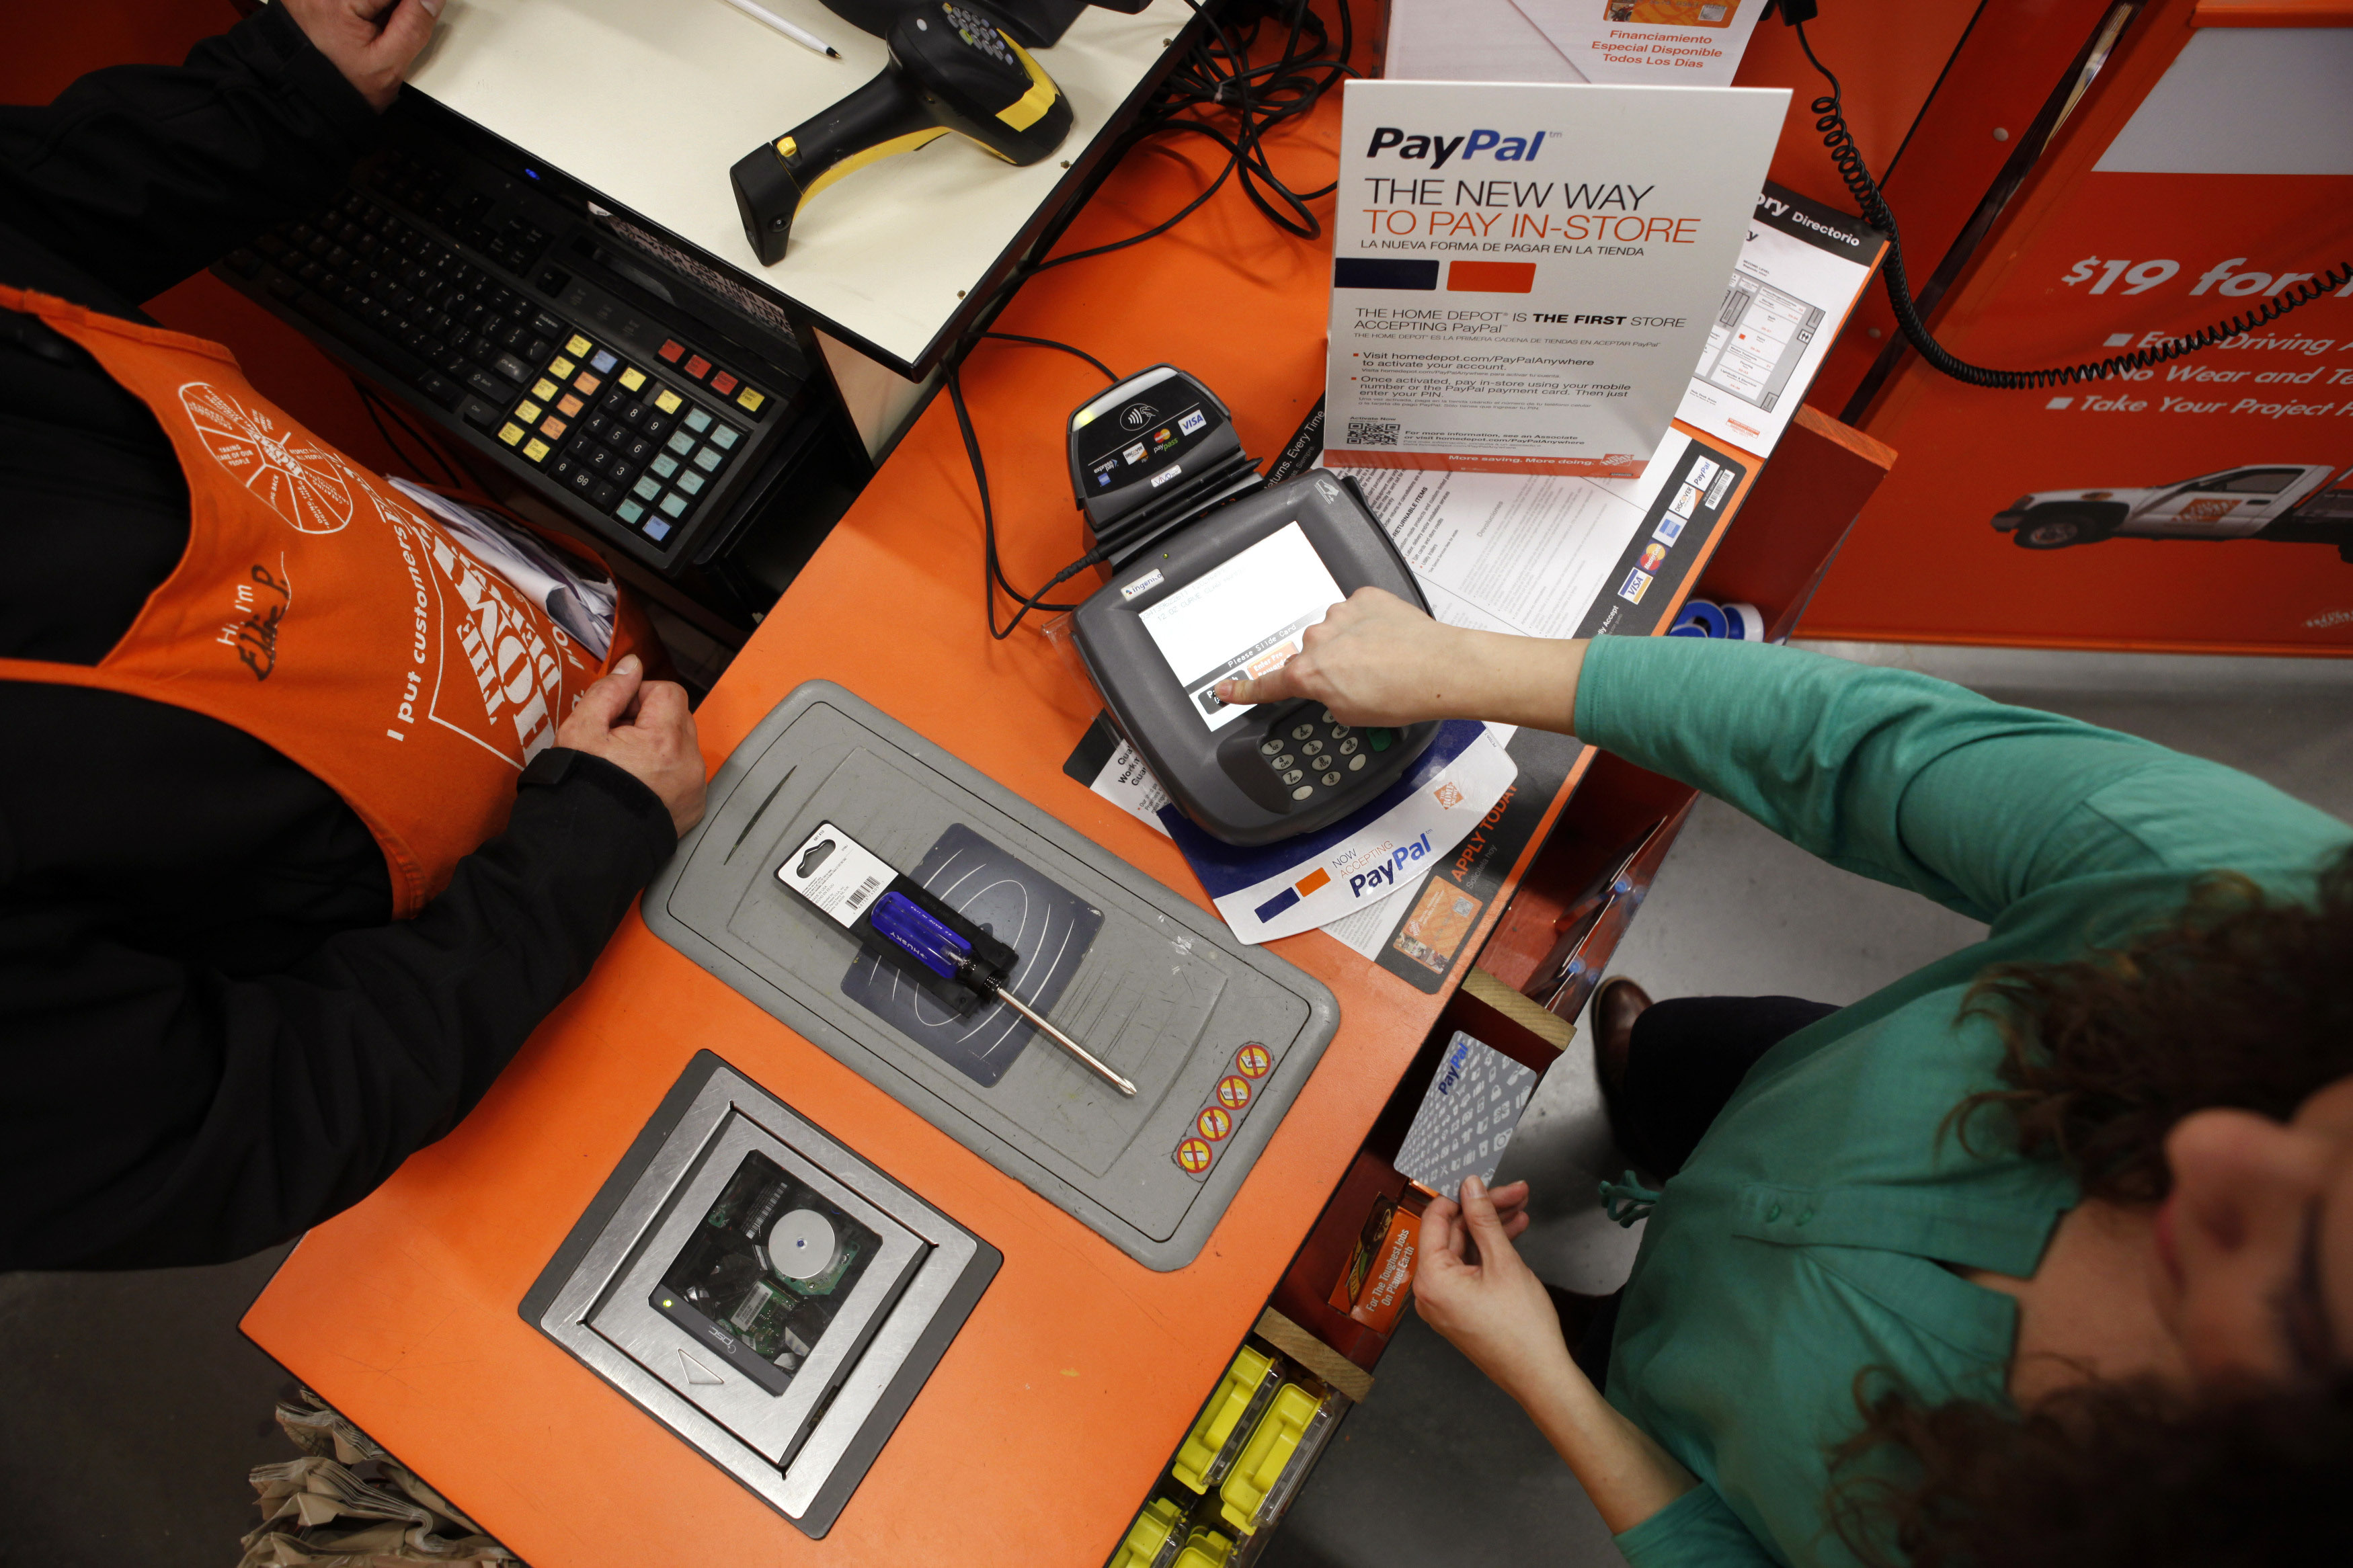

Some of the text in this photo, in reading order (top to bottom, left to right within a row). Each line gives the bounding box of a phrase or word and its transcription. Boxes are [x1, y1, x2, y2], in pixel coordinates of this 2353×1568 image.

[1609, 30, 1712, 44] Financiamiento
[1591, 40, 1722, 58] Especial Disponible
[1603, 53, 1704, 68] Todos Los Días
[1366, 127, 1546, 169] PayPal
[1364, 177, 1655, 211] THE NEW WAY
[1363, 209, 1702, 243] TO PAY IN-STORE
[1791, 210, 1860, 247] Directorio
[1361, 239, 1644, 256] LA NUEVA FORMA DE PAGAR EN LA TIENDA
[2061, 255, 2180, 295] $19
[2189, 257, 2315, 296] for
[1354, 320, 1447, 332] ACCEPTING
[1355, 308, 1388, 319] THE
[1392, 309, 1443, 320] HOME
[1513, 313, 1527, 323] IS
[1533, 313, 1569, 324] THE
[1574, 315, 1627, 325] FIRST
[1630, 317, 1687, 328] STORE
[1363, 352, 1595, 366] Visit homedepot.com/PayPalAnywhere
[1378, 360, 1423, 368] activate
[1456, 362, 1507, 370] account.
[1396, 376, 1451, 385] activated,
[1455, 379, 1476, 387] pay
[1480, 378, 1524, 387] in-store
[1528, 380, 1559, 390] using
[2166, 365, 2251, 382] Wear
[2254, 366, 2326, 384] and
[609, 395, 619, 403] 7
[1445, 385, 1484, 393] PayPal
[1488, 387, 1538, 395] payment
[1606, 390, 1628, 398] just
[630, 409, 639, 418] 8
[2080, 394, 2148, 412] Take
[2159, 397, 2228, 413] Your
[2229, 398, 2335, 419] Project
[592, 419, 600, 427] 4
[651, 421, 660, 431] 9
[1182, 414, 1203, 430] VISA
[576, 441, 584, 449] 1
[612, 431, 622, 440] 5
[219, 444, 241, 453] TAKING
[634, 444, 643, 454] 6
[1125, 446, 1144, 458] DISCOVER
[1153, 438, 1179, 454] paypass
[1266, 410, 1325, 487] eturns. Every Time
[228, 457, 251, 467] PEOPLE
[559, 462, 567, 472] 0
[595, 454, 604, 463] 2
[577, 474, 590, 487] 00
[616, 466, 625, 476] 3
[1693, 462, 1711, 485] PayPal
[1675, 486, 1693, 512] DISCOVER
[307, 501, 323, 524] DOING
[1392, 486, 1428, 540] -RETURNABLE ITEMS
[1476, 500, 1504, 538] Devoluciones
[1644, 544, 1663, 570] MasterCard
[251, 565, 290, 600] P.
[1628, 576, 1644, 596] VISA
[216, 584, 254, 646] Hi, I'm
[1603, 605, 1620, 628] Accept
[387, 521, 428, 741] I put customers
[1227, 624, 1298, 668] Please Slide Card
[456, 613, 506, 726] THE
[1252, 651, 1283, 672] Enter Pro
[1443, 782, 1455, 809] HOME
[1451, 788, 1459, 805] DEPOT
[1450, 784, 1519, 883] APPLY TODAY
[1332, 848, 1357, 868] NOW
[1340, 840, 1394, 878] ACCEPTING
[1485, 844, 1499, 863] hoy
[1349, 833, 1432, 899] PayPal
[928, 918, 943, 930] MADE
[889, 931, 921, 955] HUSKY
[1438, 1042, 1469, 1096] PayPal
[1365, 1229, 1410, 1313] For The Toughest Jobs
[1381, 1245, 1415, 1307] On Planet Earth
